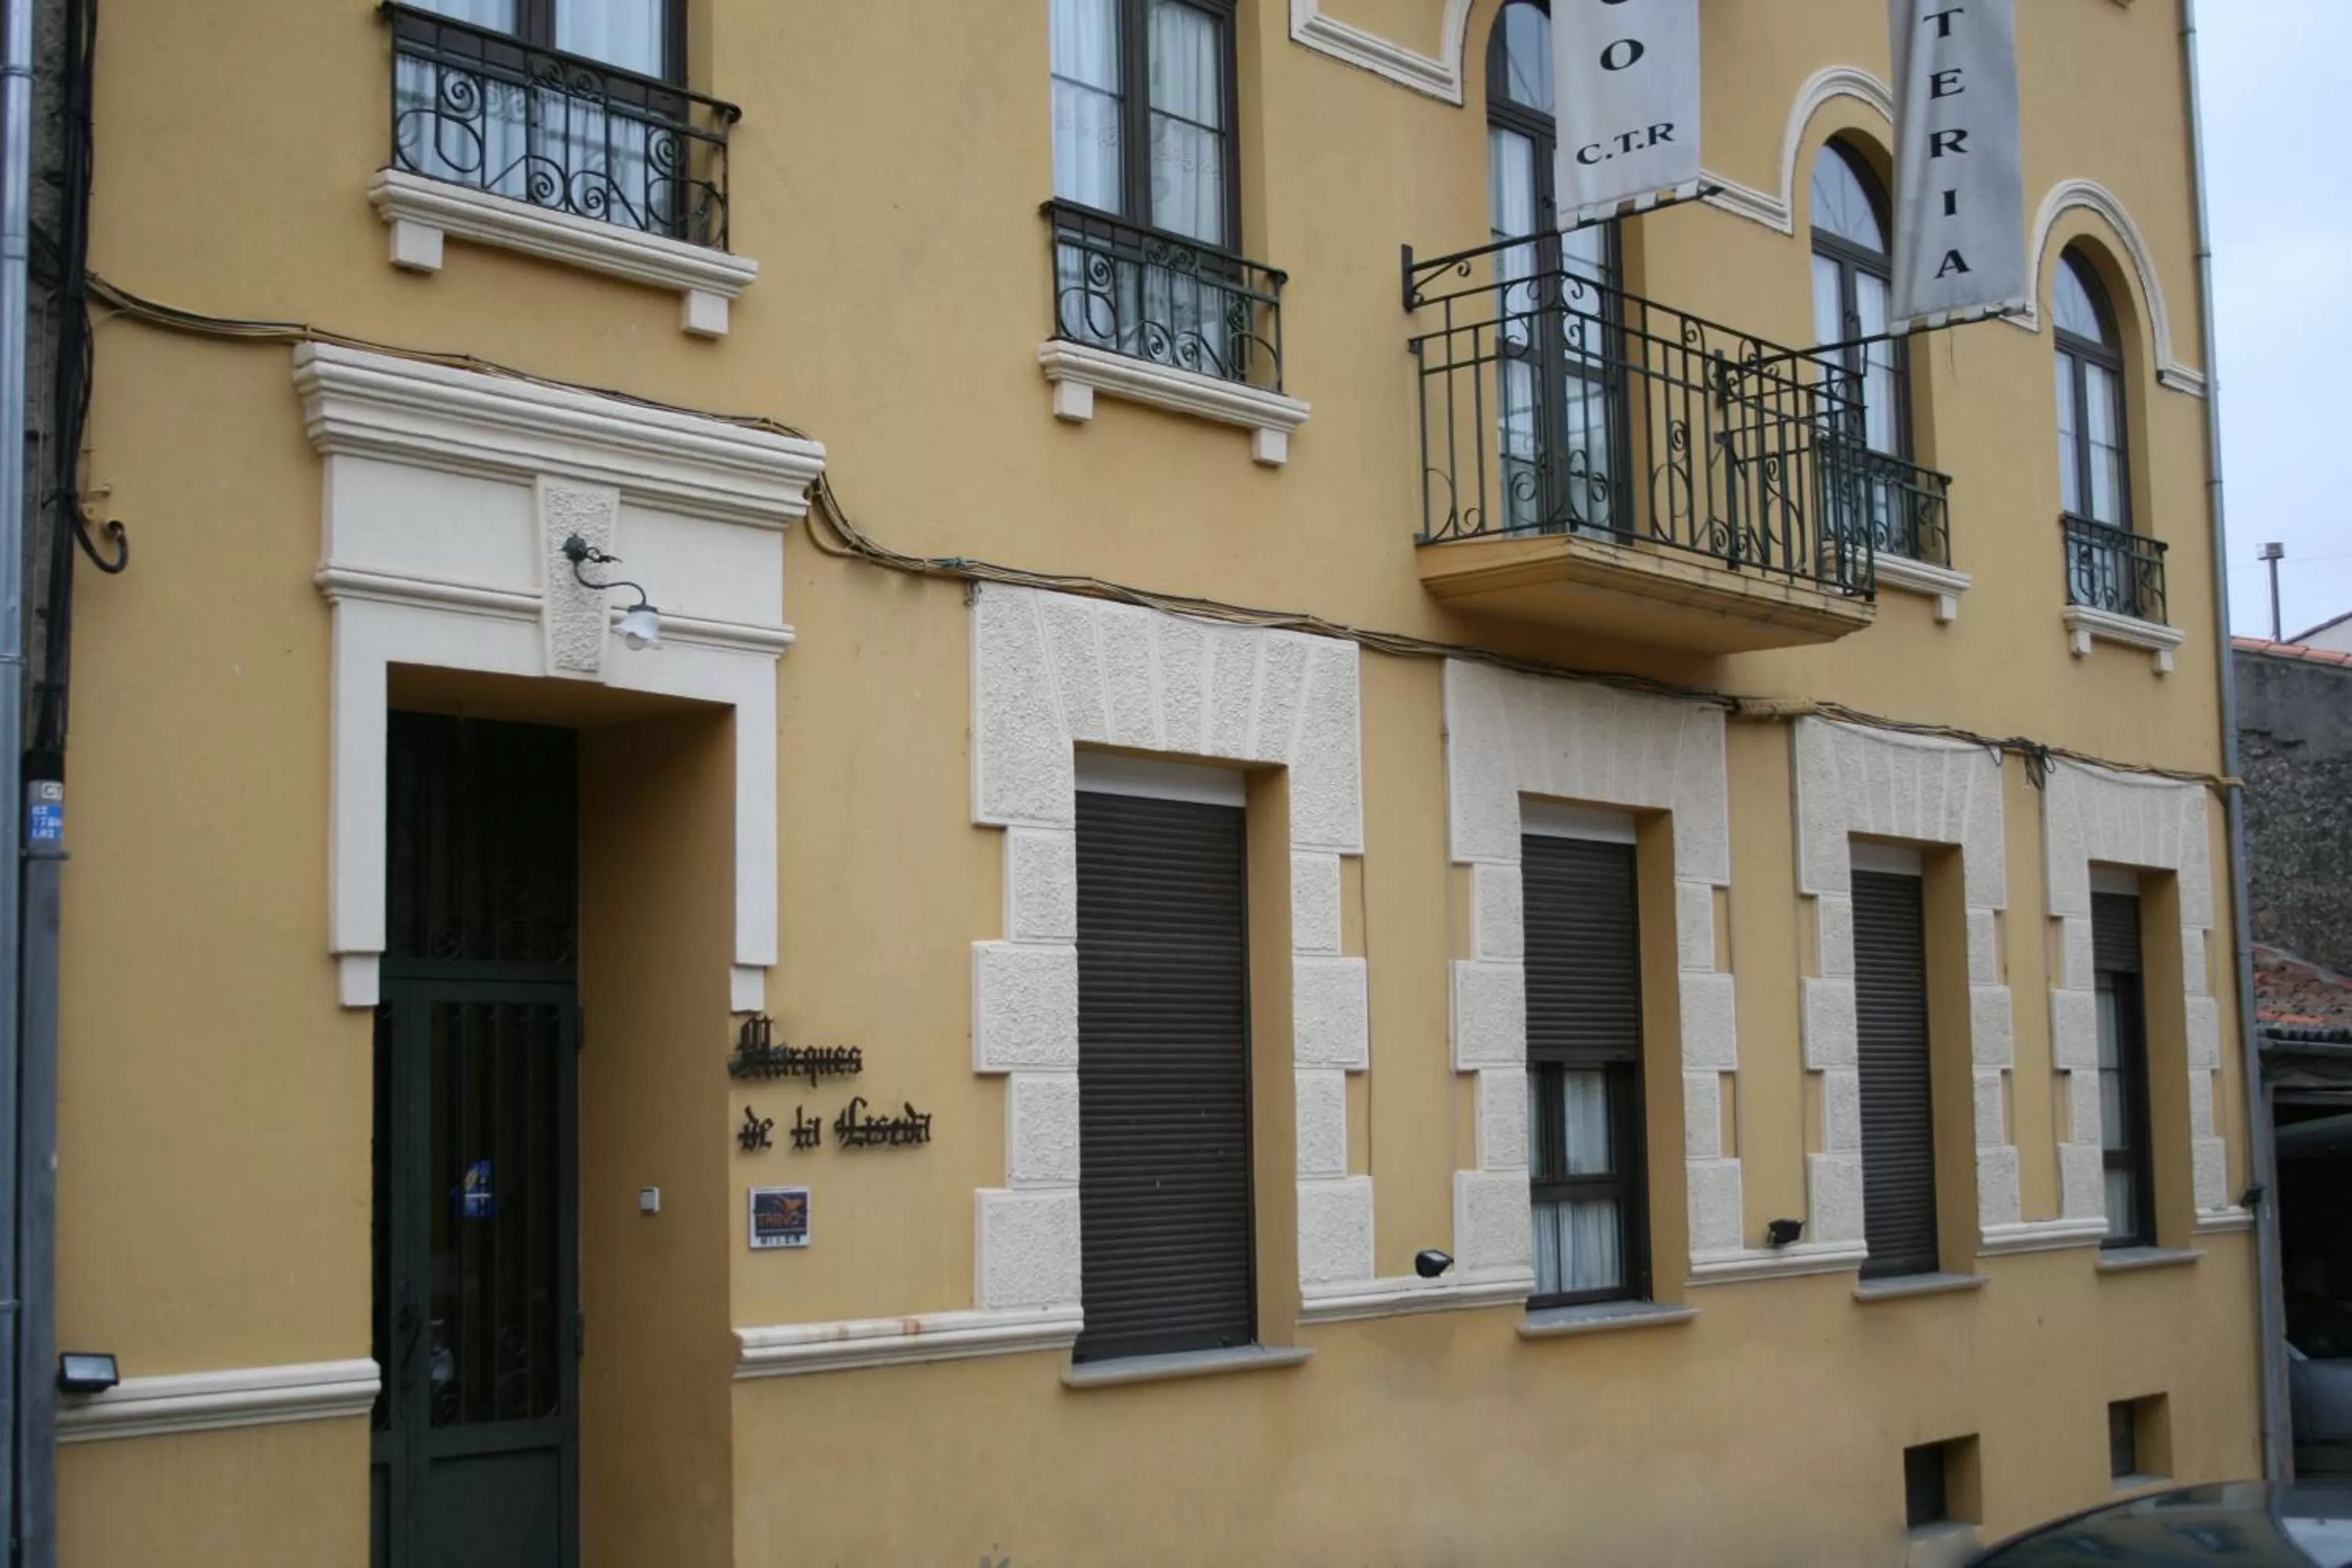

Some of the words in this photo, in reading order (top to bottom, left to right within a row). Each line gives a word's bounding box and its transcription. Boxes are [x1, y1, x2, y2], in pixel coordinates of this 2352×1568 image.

[1576, 122, 1675, 165] C.T.R
[1922, 8, 1972, 280] TERIA
[738, 1105, 775, 1149] de
